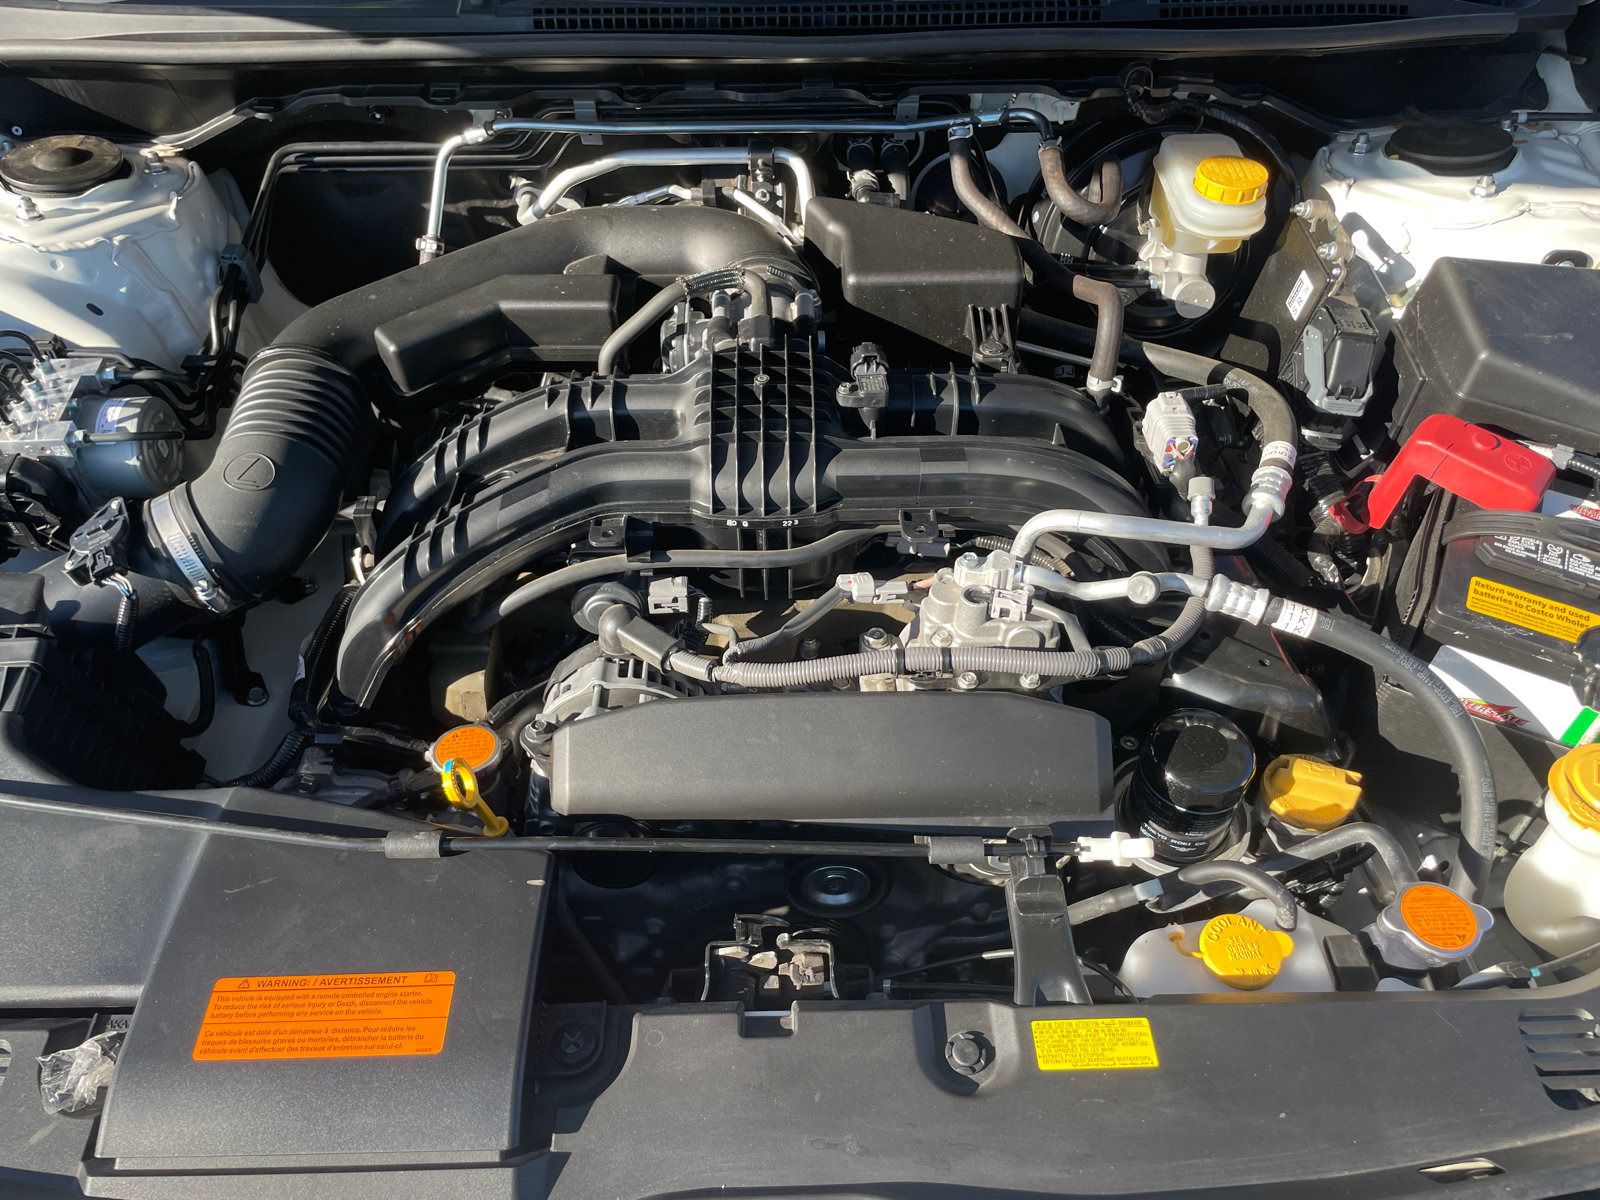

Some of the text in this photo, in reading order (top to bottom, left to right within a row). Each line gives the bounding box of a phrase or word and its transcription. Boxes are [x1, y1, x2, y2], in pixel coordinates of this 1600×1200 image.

[1473, 588, 1513, 606] batteries
[1514, 600, 1524, 609] to
[1526, 604, 1554, 618] Costco
[1474, 580, 1590, 622] Return warranty and used
[1302, 606, 1310, 616] K
[1298, 616, 1308, 626] K
[1206, 916, 1268, 942] COOLANT
[1227, 936, 1244, 944] SEE
[1226, 942, 1259, 952] OWNERS
[1229, 950, 1262, 962] MANUAL
[257, 978, 310, 988] WARNING:
[319, 976, 408, 986] AVERTISSEMENT
[264, 994, 295, 1004] equipped
[258, 1010, 294, 1019] performing
[216, 1029, 243, 1037] véhicule
[238, 1037, 271, 1045] blessures
[342, 1034, 379, 1042] débrancher
